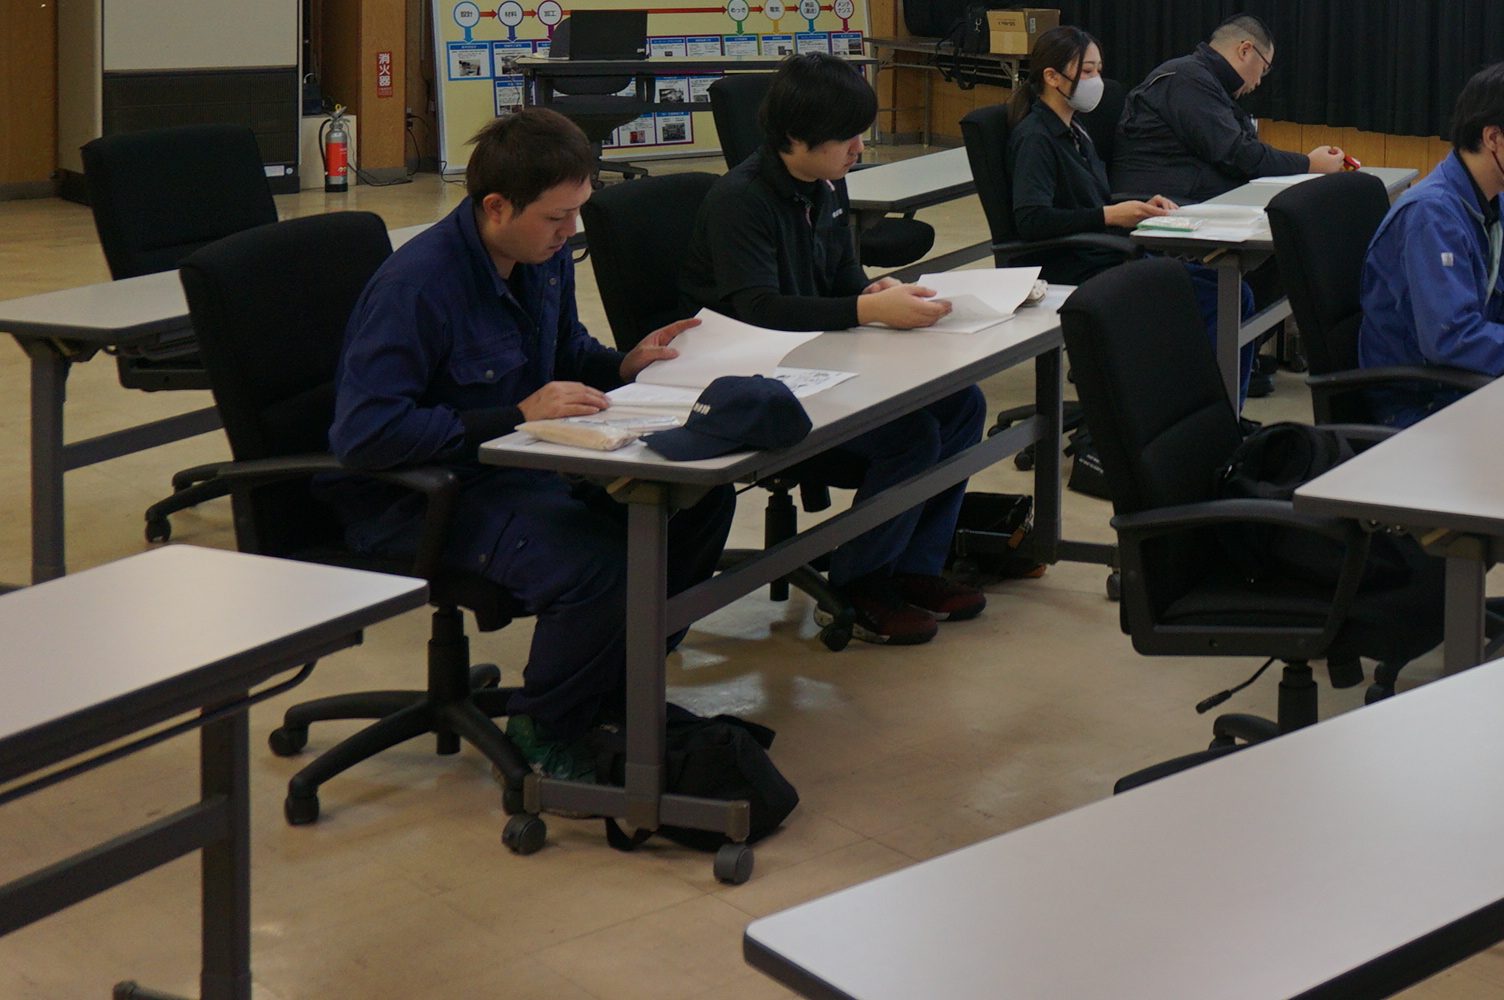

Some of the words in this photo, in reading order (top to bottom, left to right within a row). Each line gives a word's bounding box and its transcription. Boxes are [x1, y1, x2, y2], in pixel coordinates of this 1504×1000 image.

[543, 9, 557, 17] 加工
[378, 52, 391, 87] 消火器
